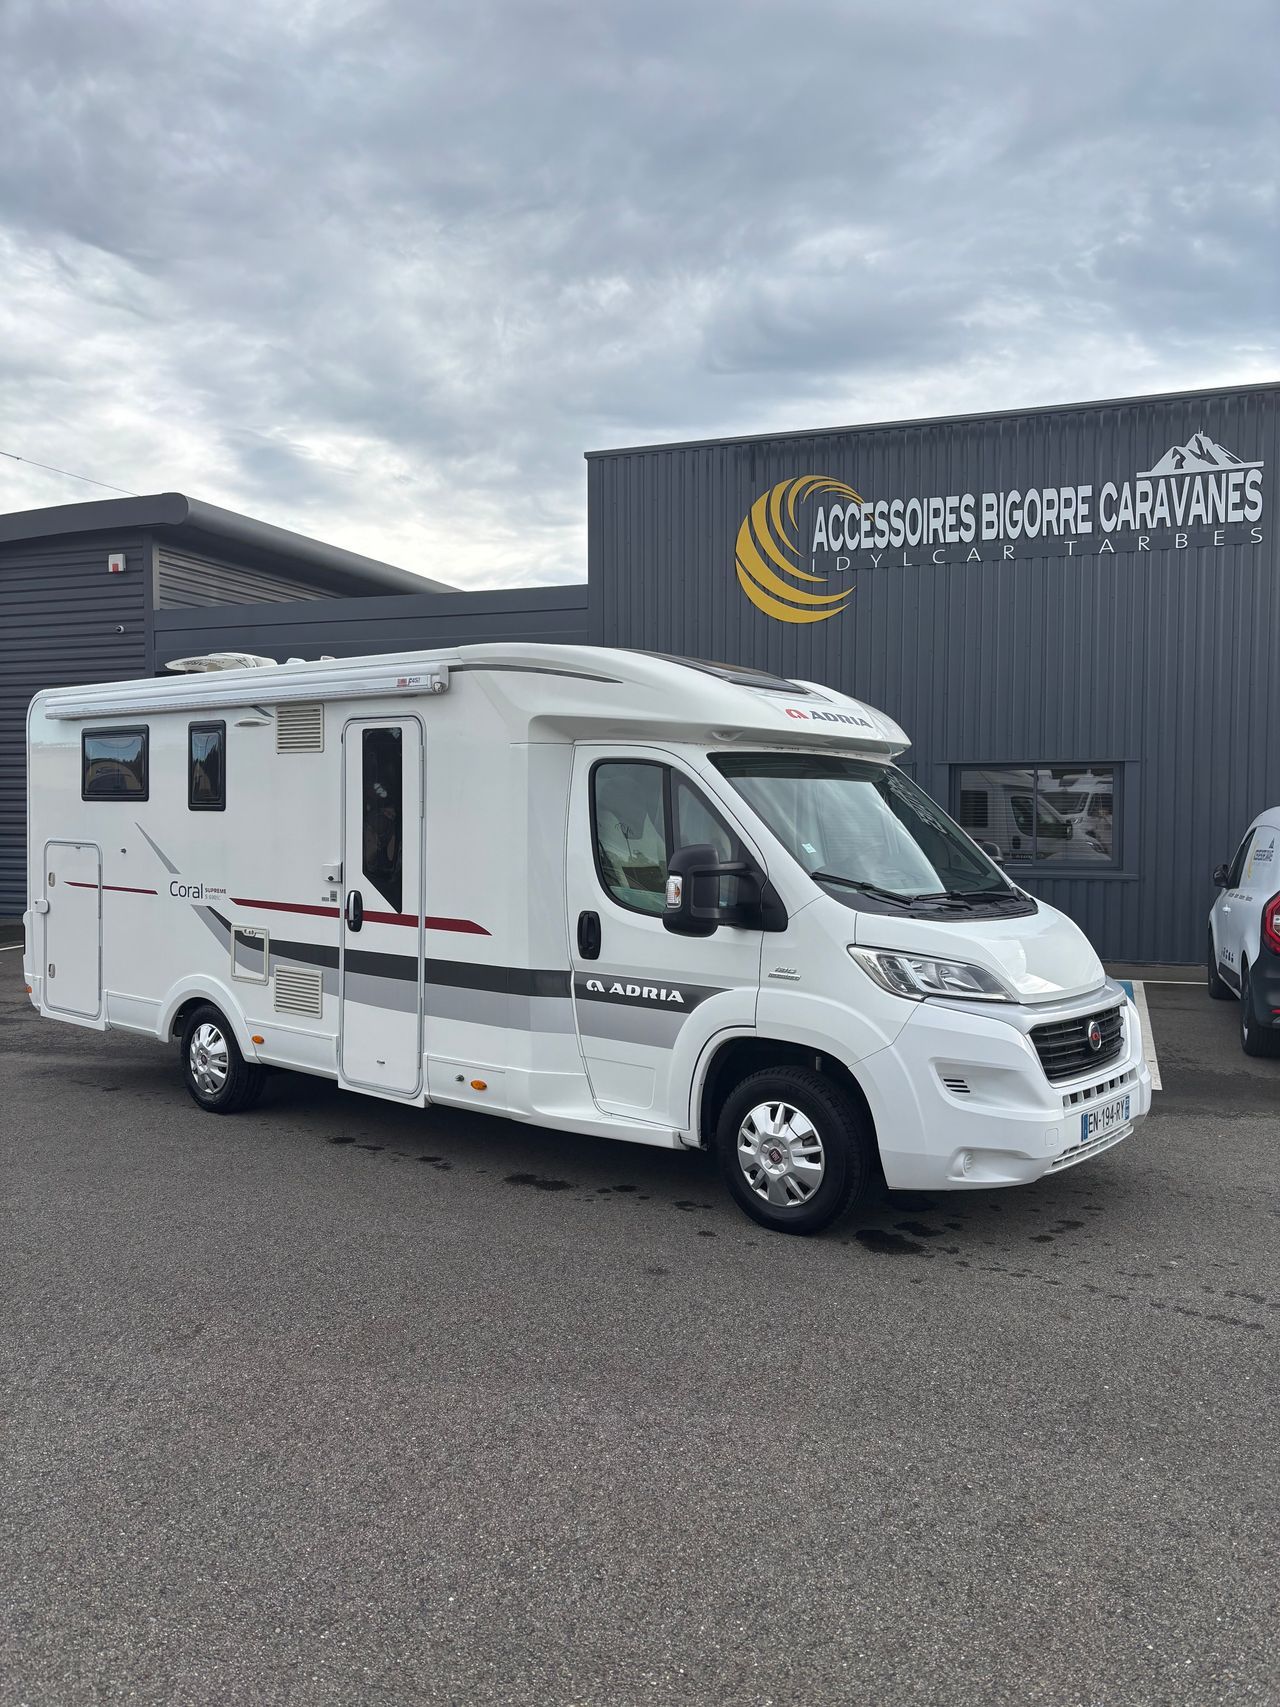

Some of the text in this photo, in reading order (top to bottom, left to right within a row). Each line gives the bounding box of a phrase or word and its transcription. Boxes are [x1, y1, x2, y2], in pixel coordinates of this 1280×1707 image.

[812, 469, 1264, 552] ACCESSOIRES BIGORRE CARAVANES
[812, 527, 1264, 573] IDYLCAR TARBES
[809, 710, 874, 729] ADRIA
[169, 880, 204, 899] Coral
[204, 887, 227, 895] SUPREME
[609, 982, 685, 1004] ADRIA
[1088, 1099, 1125, 1134] EN-194-RY
